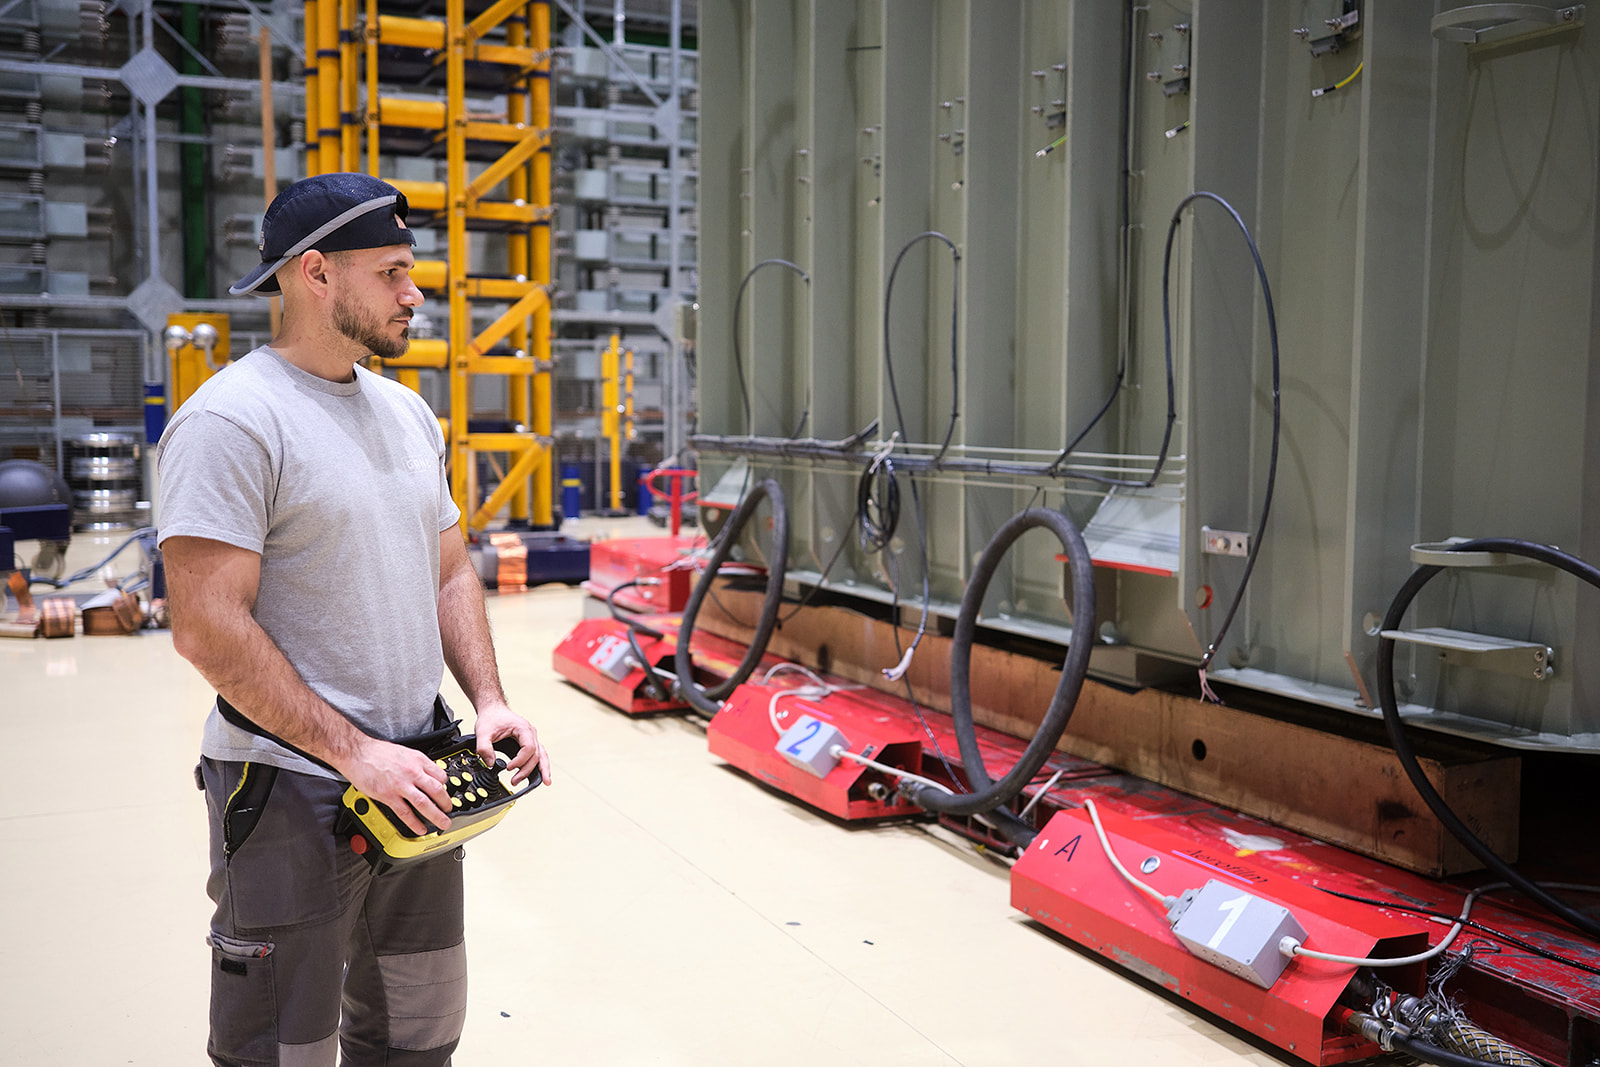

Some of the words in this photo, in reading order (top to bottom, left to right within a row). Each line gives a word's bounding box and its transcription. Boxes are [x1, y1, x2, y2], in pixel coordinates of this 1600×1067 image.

[786, 721, 821, 756] 2
[1054, 834, 1082, 862] A
[1206, 893, 1253, 949] 1
